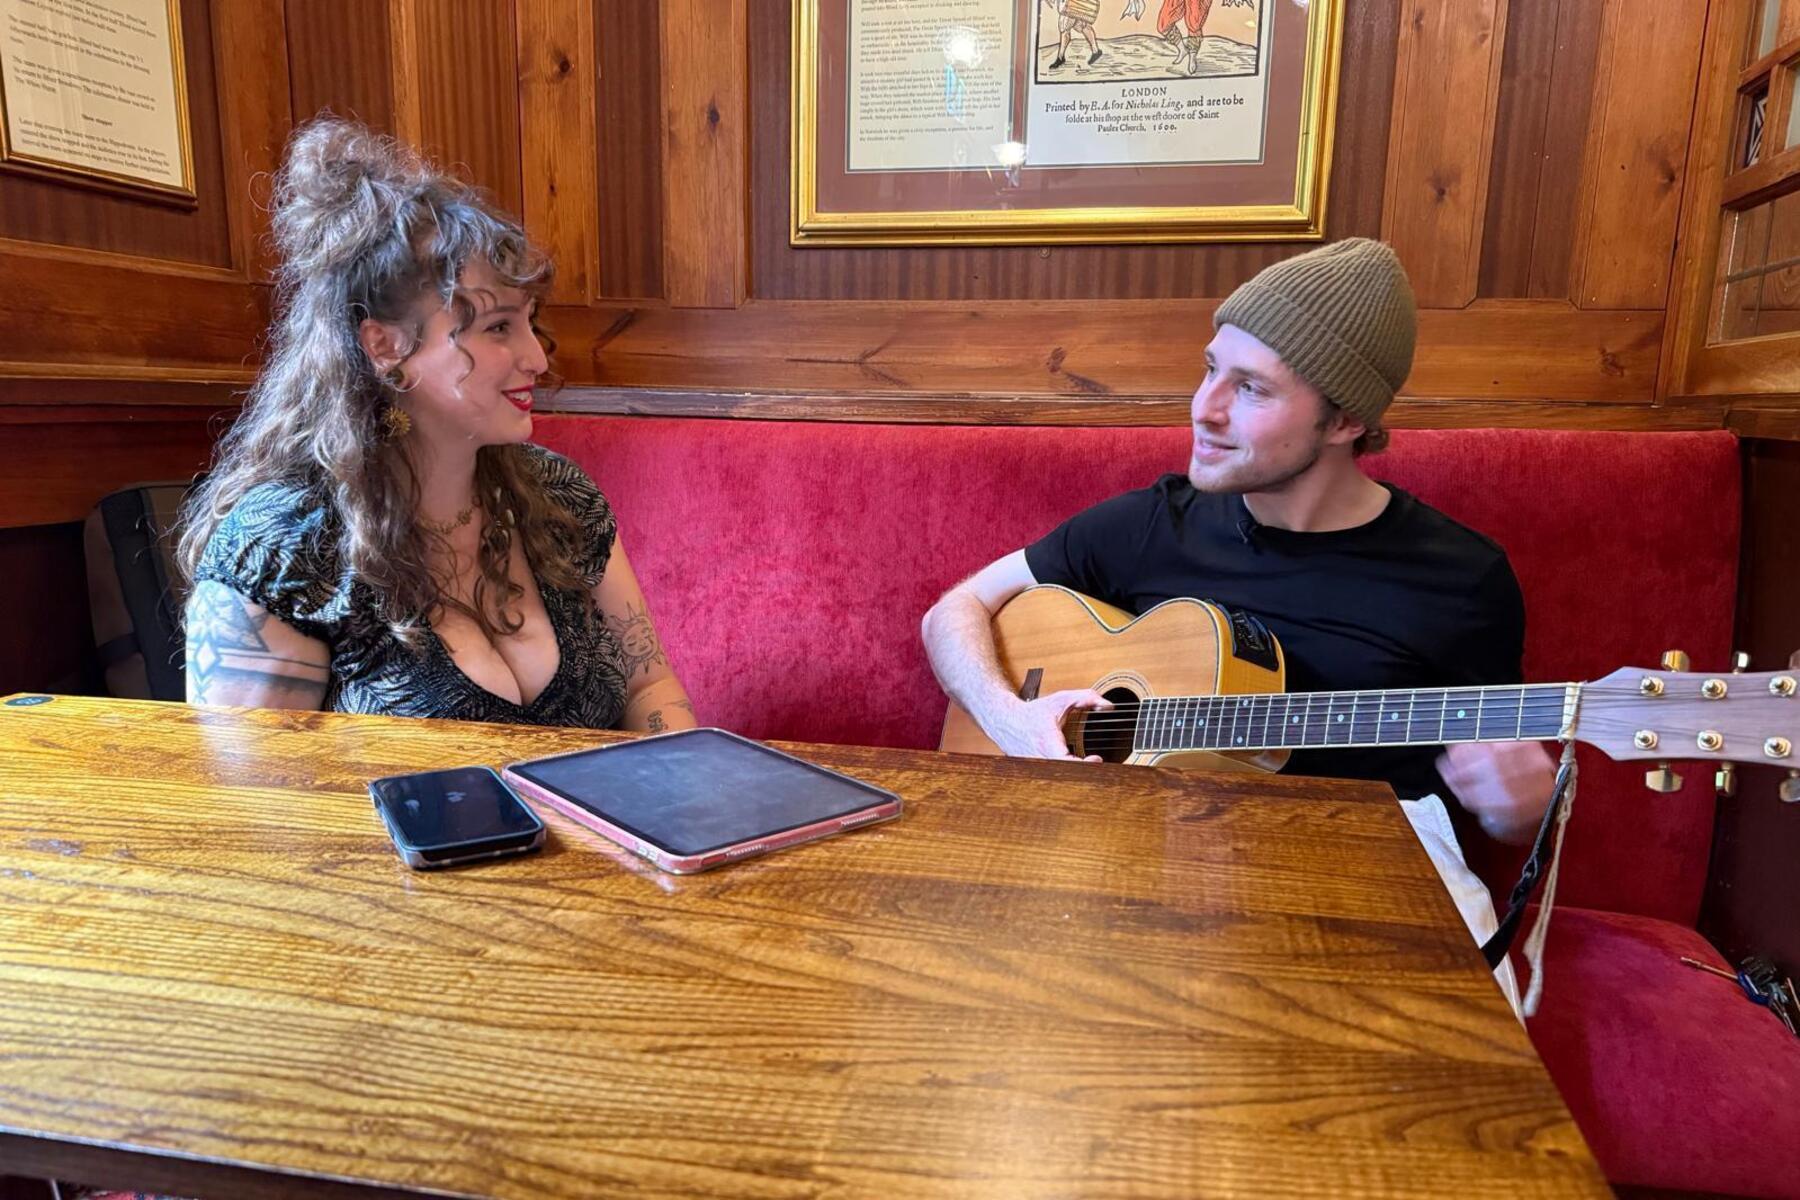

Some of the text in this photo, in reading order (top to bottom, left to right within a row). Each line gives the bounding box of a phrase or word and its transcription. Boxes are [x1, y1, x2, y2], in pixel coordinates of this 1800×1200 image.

[1121, 86, 1167, 98] LONDON
[1045, 99, 1076, 112] Printed
[1079, 99, 1090, 115] by
[1111, 99, 1123, 110] for
[1125, 98, 1159, 110] Nicholas
[1186, 95, 1204, 107] and
[1206, 98, 1221, 107] are
[1222, 97, 1232, 106] to
[1233, 93, 1244, 105] be
[1130, 112, 1143, 122] the
[1186, 109, 1198, 120] of
[1198, 109, 1220, 120] Saint
